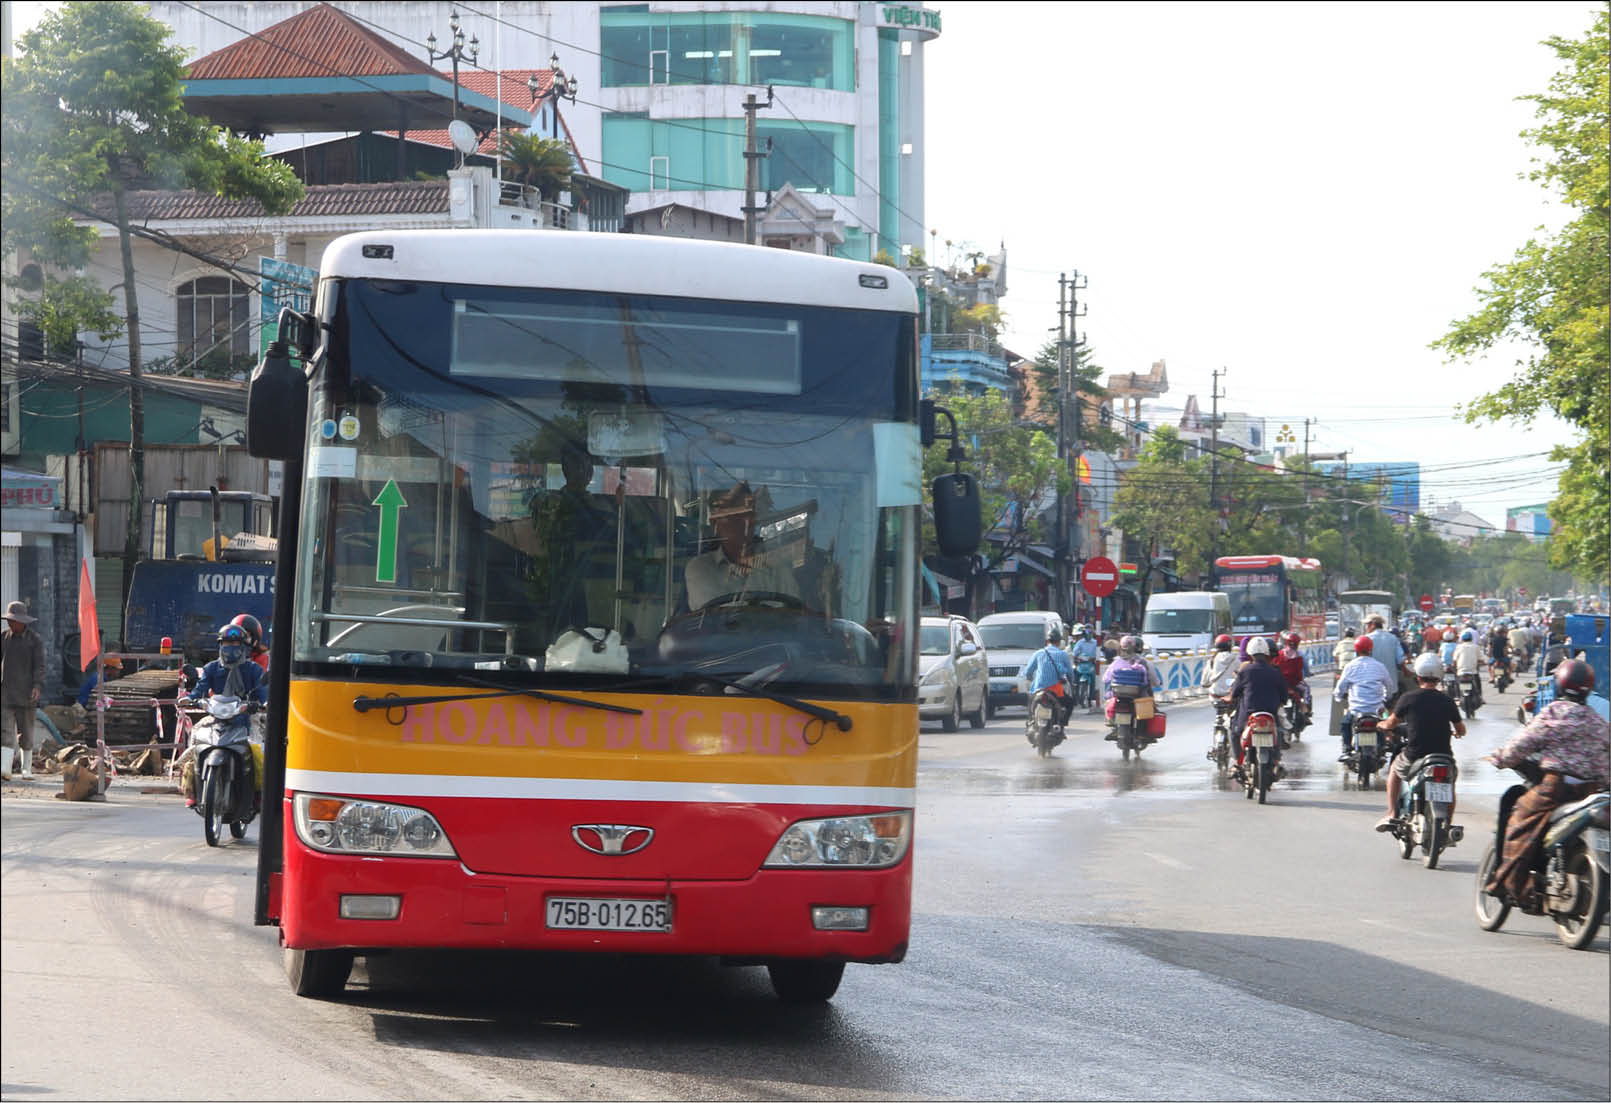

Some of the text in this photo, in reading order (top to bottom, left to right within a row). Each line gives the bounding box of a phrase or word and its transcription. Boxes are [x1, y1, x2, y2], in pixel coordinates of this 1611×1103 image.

[1, 483, 54, 505] PHÚ
[720, 711, 809, 757] BUS
[551, 901, 667, 928] 75B-012.65
